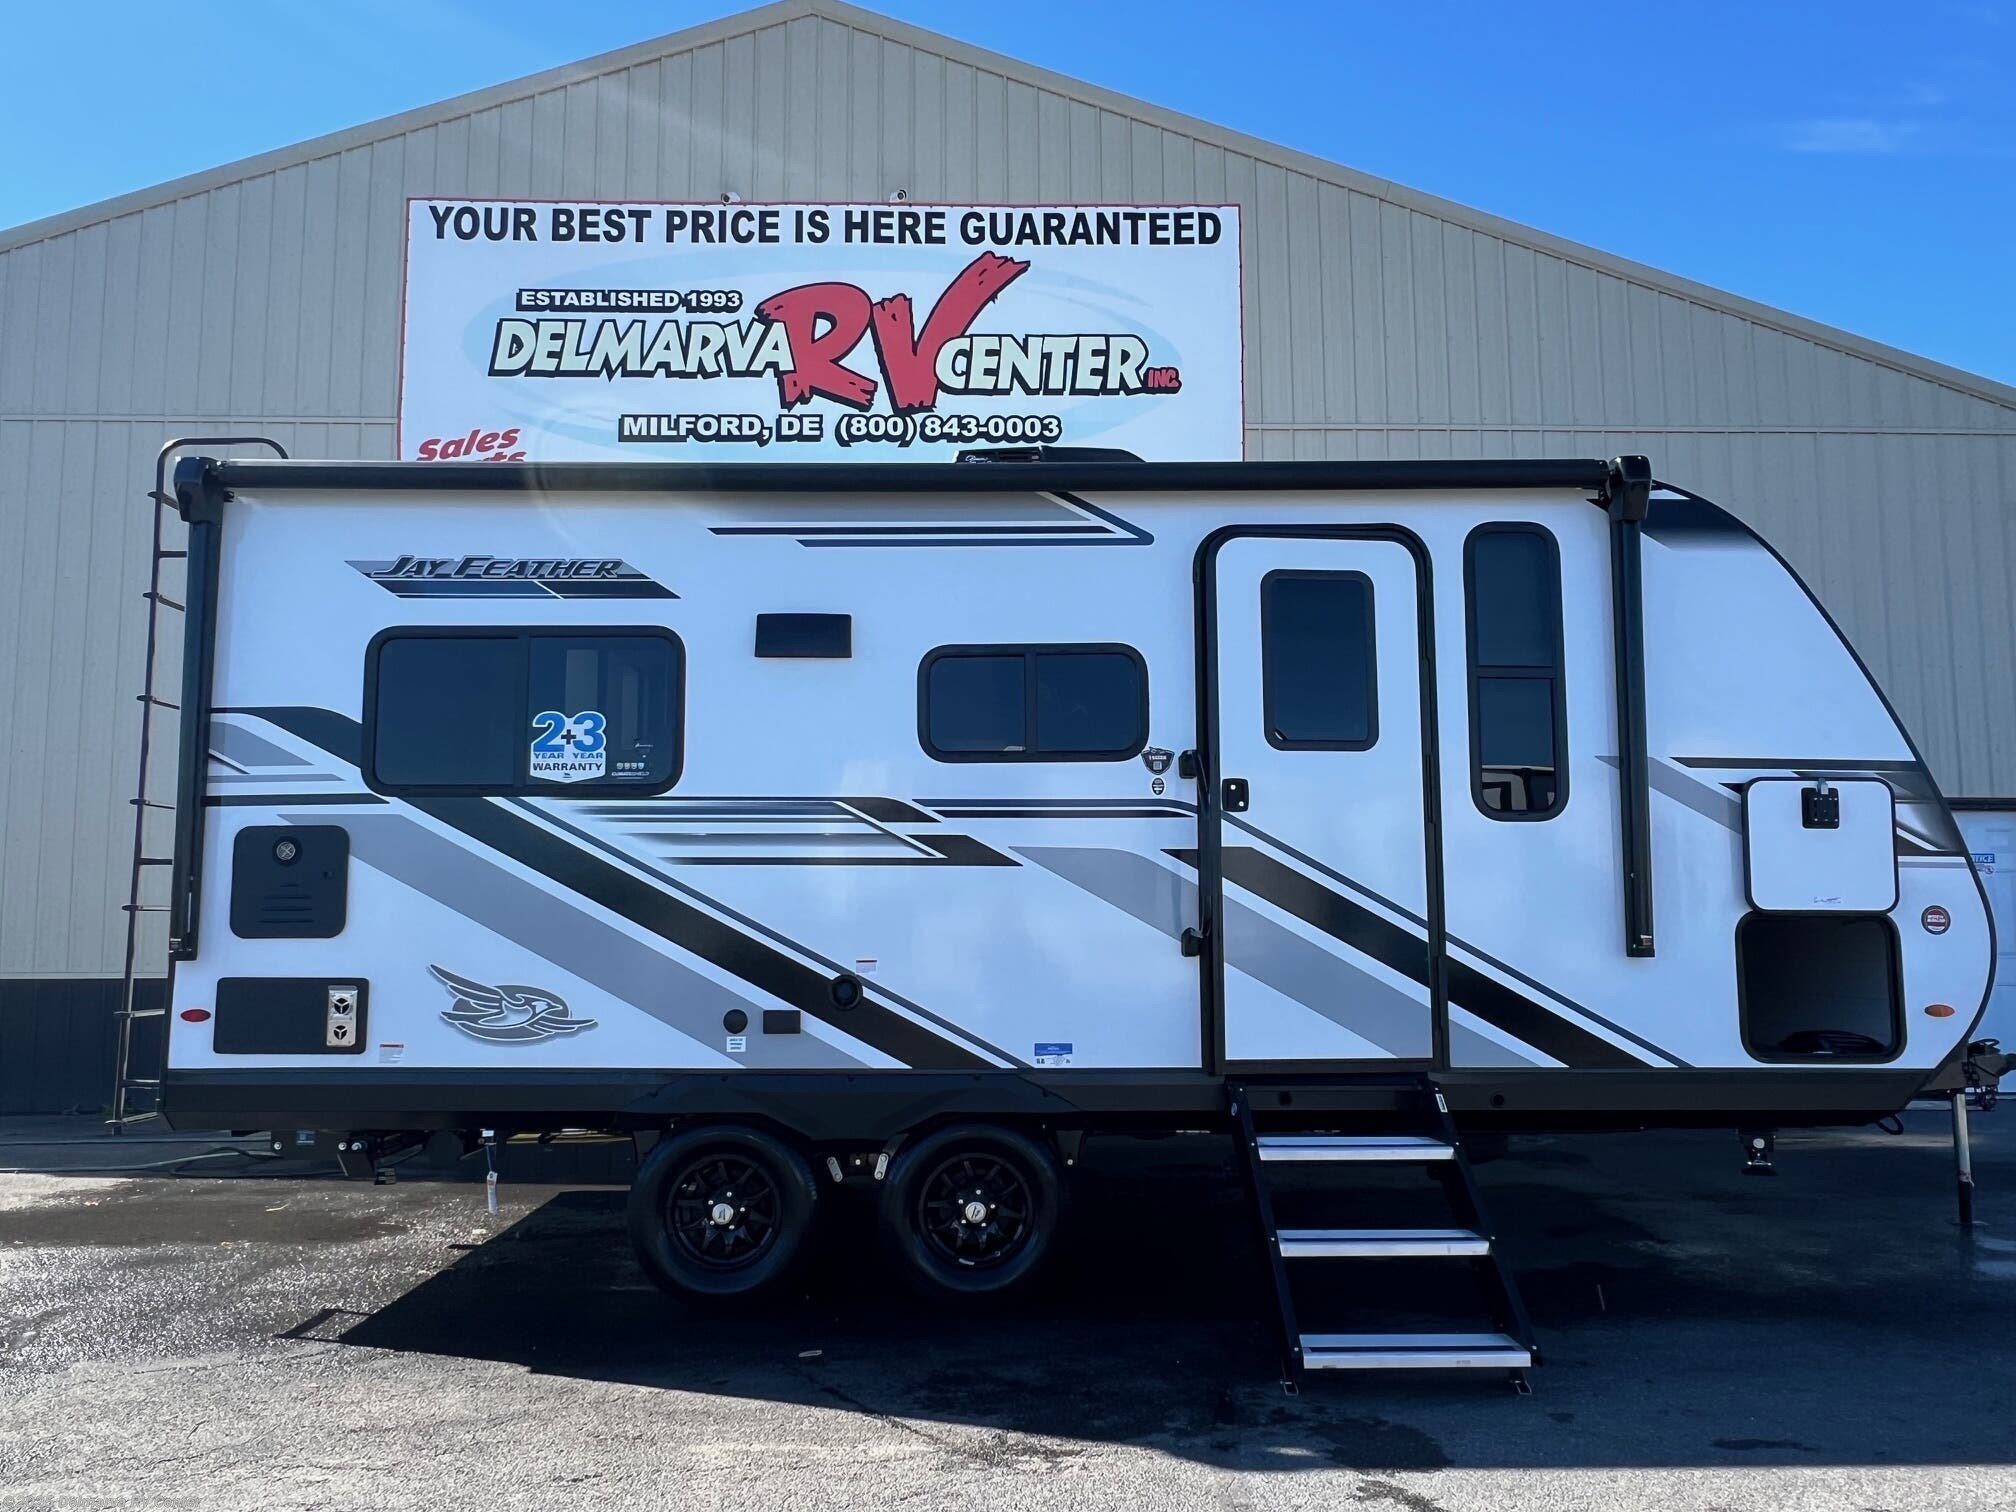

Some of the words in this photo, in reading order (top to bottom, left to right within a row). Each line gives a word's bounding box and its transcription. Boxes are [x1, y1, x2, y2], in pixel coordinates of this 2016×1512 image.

[428, 205, 538, 242] YOUR
[551, 208, 652, 244] BEST
[665, 209, 780, 244] PRICE
[795, 210, 830, 244] IS
[844, 210, 946, 245] HERE
[959, 210, 1223, 246] GUARANTEED
[519, 290, 681, 310] ESTABLISHED
[685, 291, 742, 309] 1993
[491, 319, 796, 378] DELMARVA
[755, 251, 1031, 413] RV
[935, 334, 1148, 393] CENTER
[621, 415, 774, 443] MILFORD,
[780, 415, 822, 438] DE
[838, 415, 915, 441] (800)
[922, 415, 1061, 439] 843-0003
[416, 428, 521, 461] sales
[452, 555, 623, 579] FEATHER
[532, 762, 603, 772] WARRANTY
[533, 752, 565, 760] YEAR
[572, 752, 604, 760] YEAR
